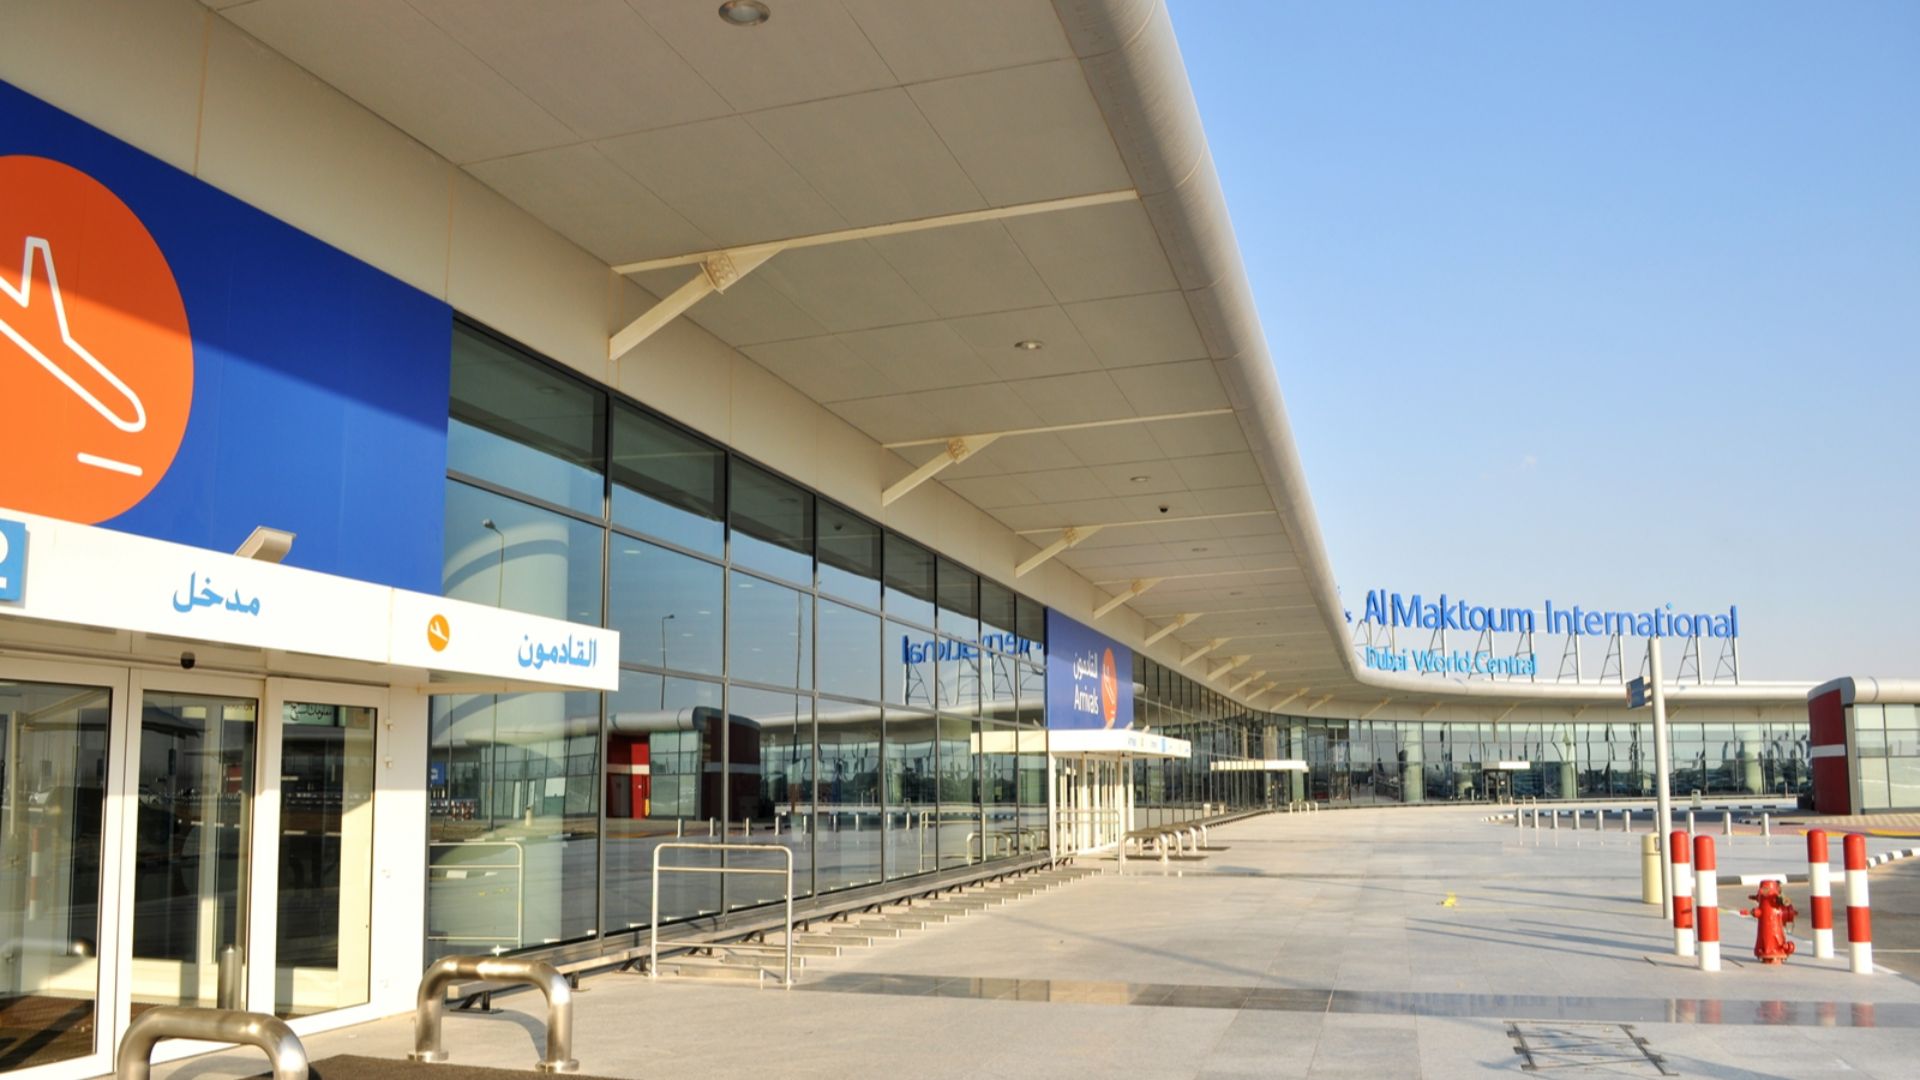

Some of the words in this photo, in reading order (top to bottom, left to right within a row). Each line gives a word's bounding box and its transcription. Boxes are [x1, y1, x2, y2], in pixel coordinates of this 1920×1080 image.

[173, 571, 261, 616] مدخل
[1364, 589, 1388, 625] Al
[1390, 593, 1536, 633] Maktoum
[1545, 600, 1739, 638] International
[518, 633, 597, 670] القادمون
[1365, 646, 1408, 672] Dubai
[1411, 650, 1471, 673] World
[1474, 651, 1538, 676] Central
[1073, 684, 1099, 715] Arrivals
